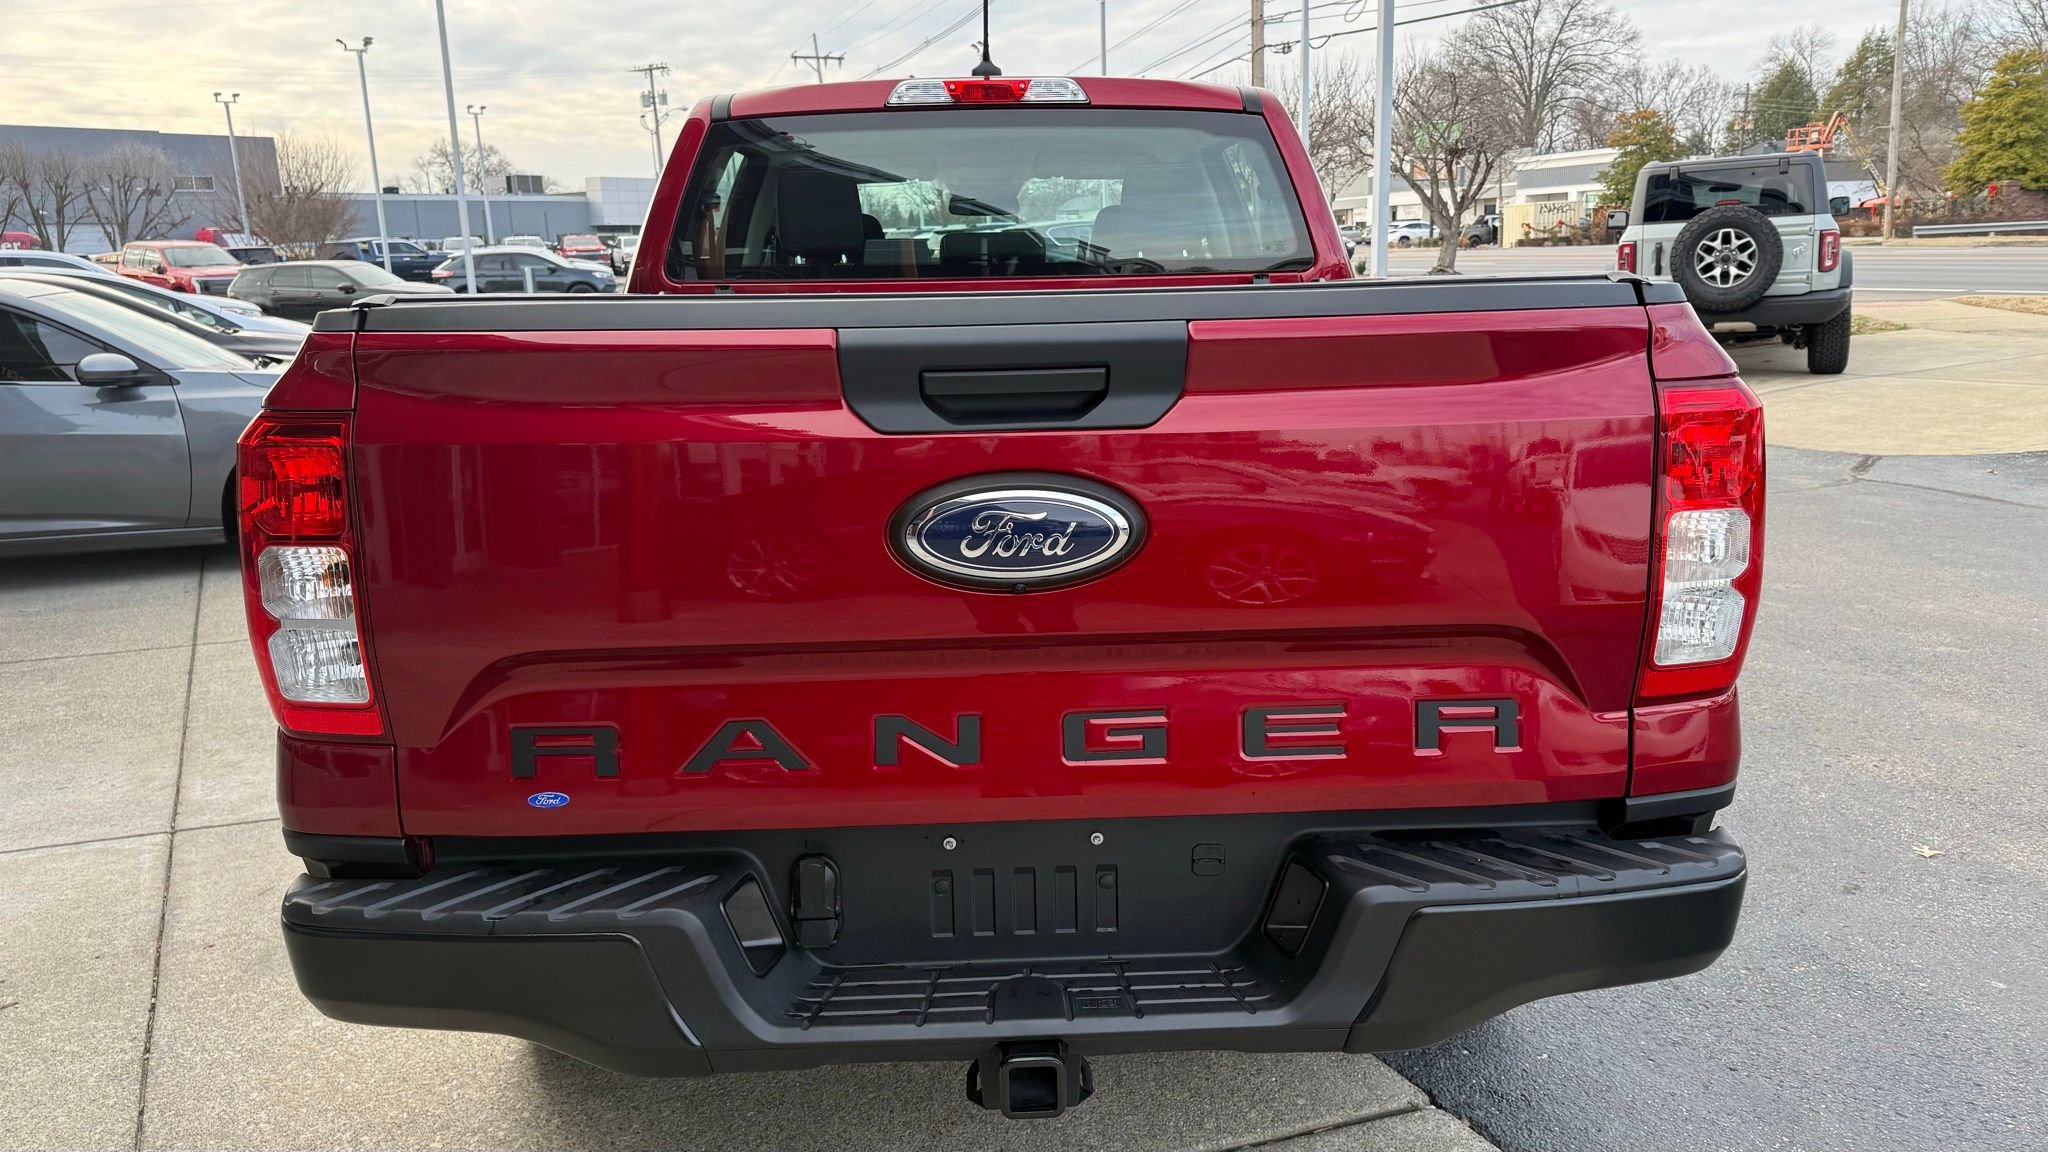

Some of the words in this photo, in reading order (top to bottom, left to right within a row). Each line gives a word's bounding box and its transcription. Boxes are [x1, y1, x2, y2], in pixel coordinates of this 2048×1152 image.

[960, 511, 1076, 557] Ford
[510, 698, 1522, 778] RANGER
[536, 794, 561, 805] Ford
